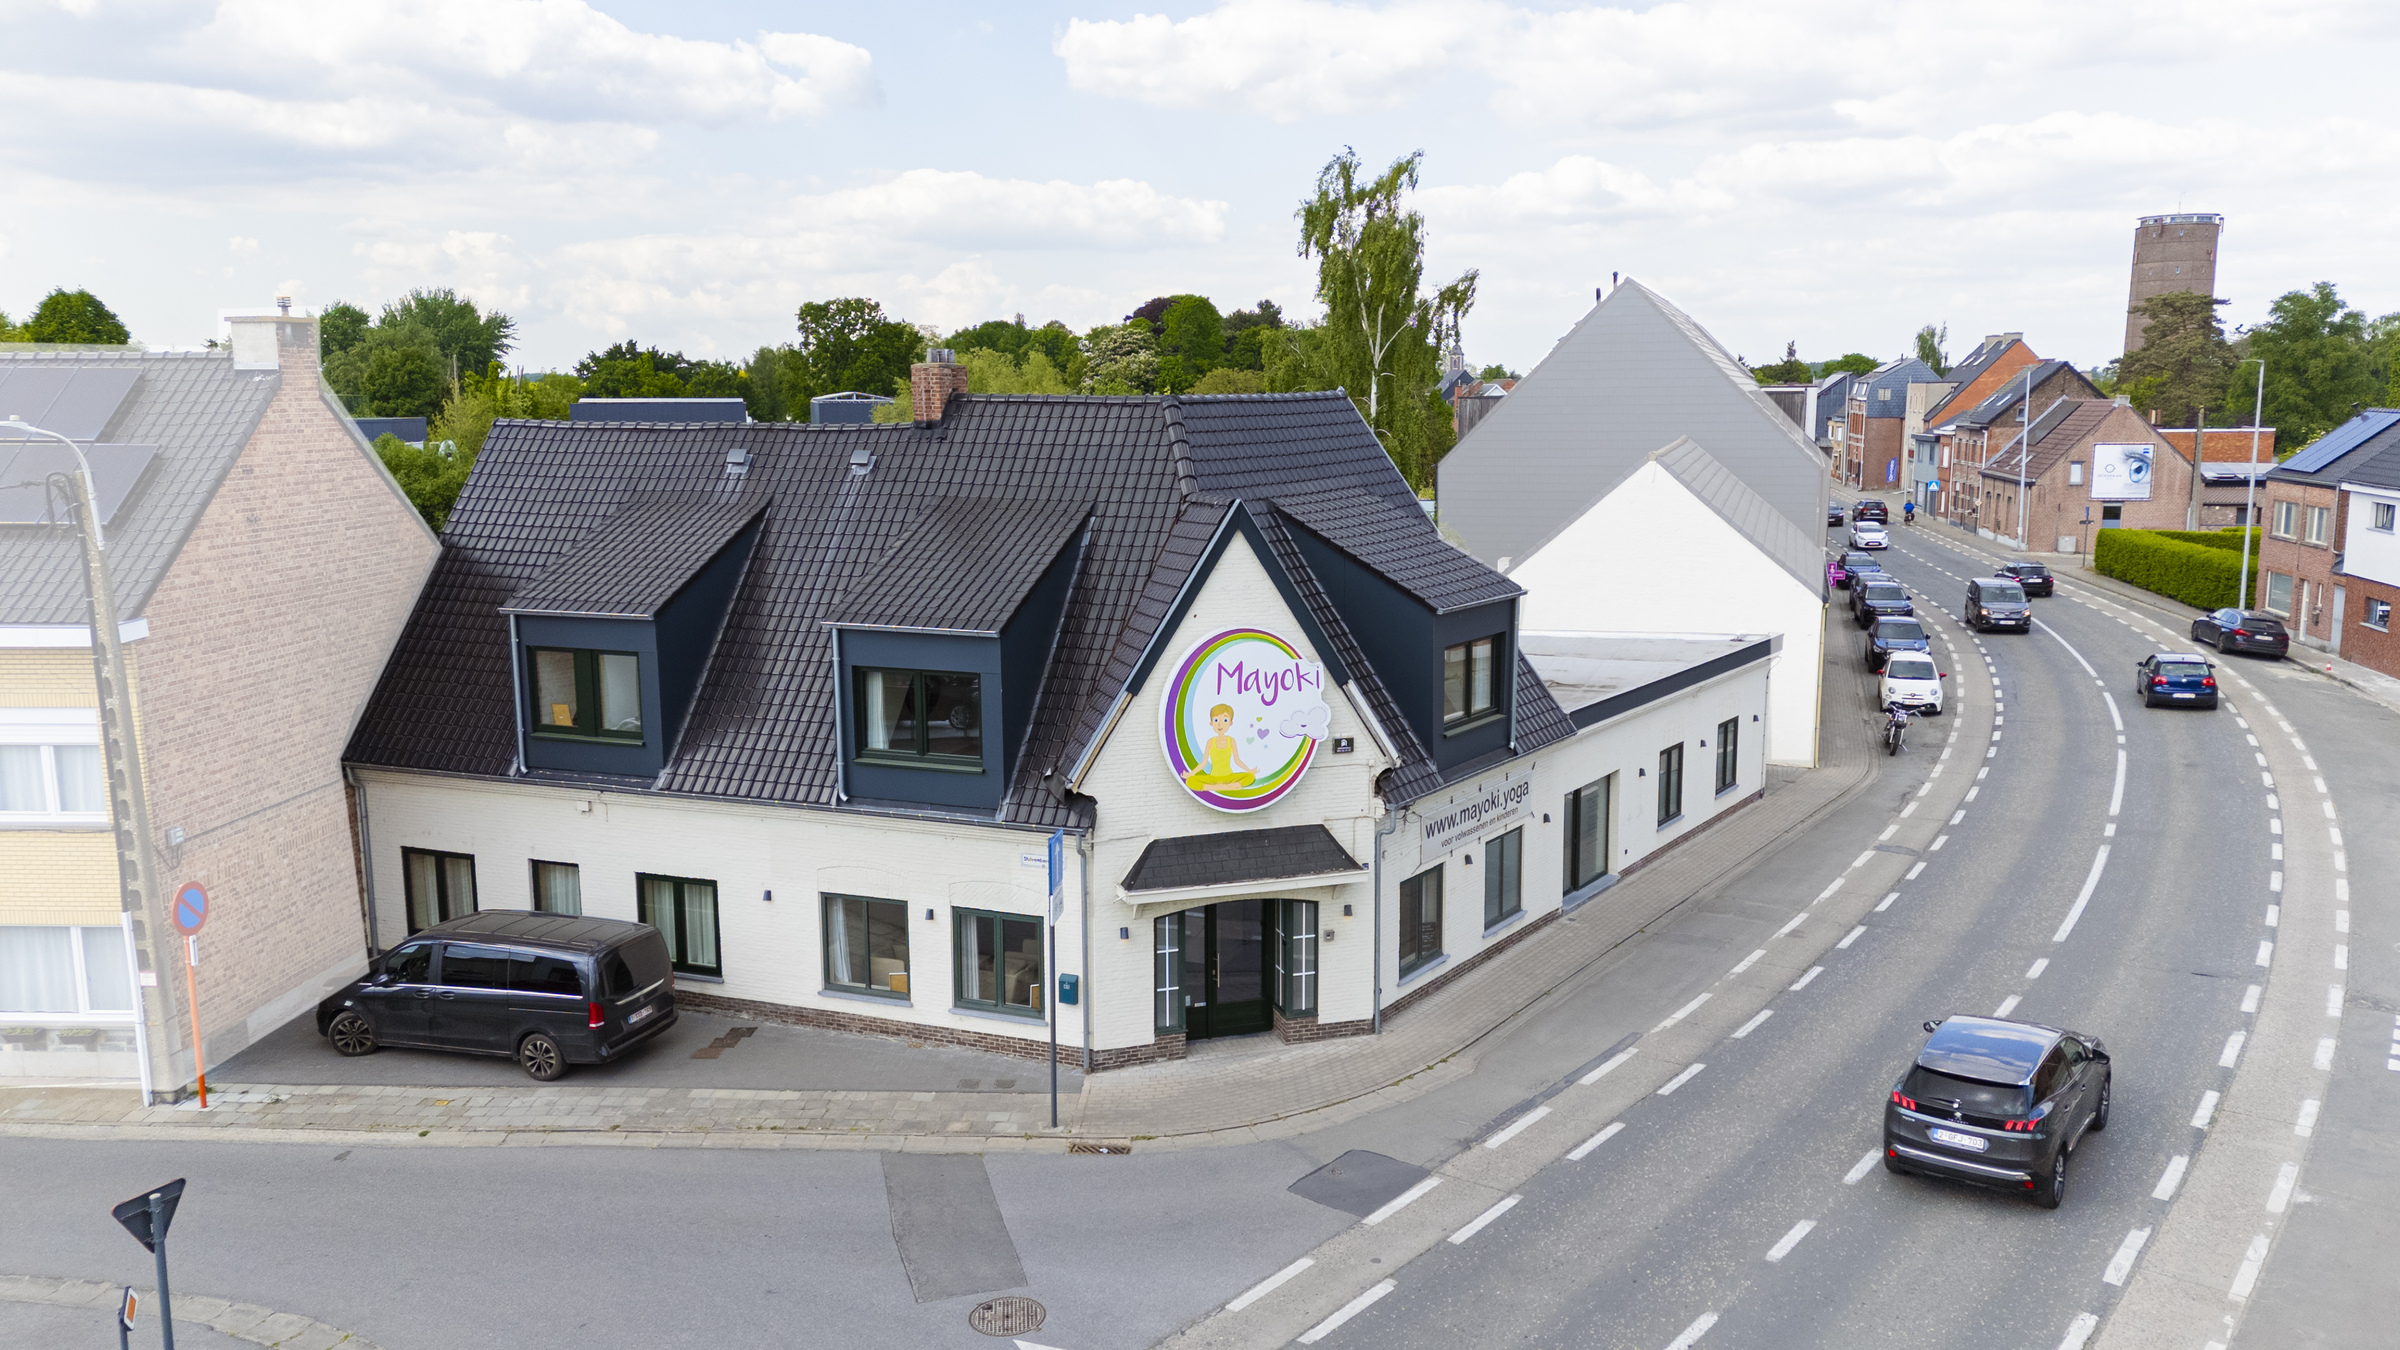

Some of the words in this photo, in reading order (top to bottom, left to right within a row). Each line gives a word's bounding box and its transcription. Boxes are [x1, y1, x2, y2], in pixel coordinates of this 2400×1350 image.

[1217, 660, 1321, 706] Mayoki
[1425, 781, 1529, 839] www.mayoki.yoga
[1441, 836, 1454, 847] voor
[1455, 820, 1488, 842] volwassenen
[1489, 817, 1496, 825] en
[1496, 807, 1519, 822] kinderen
